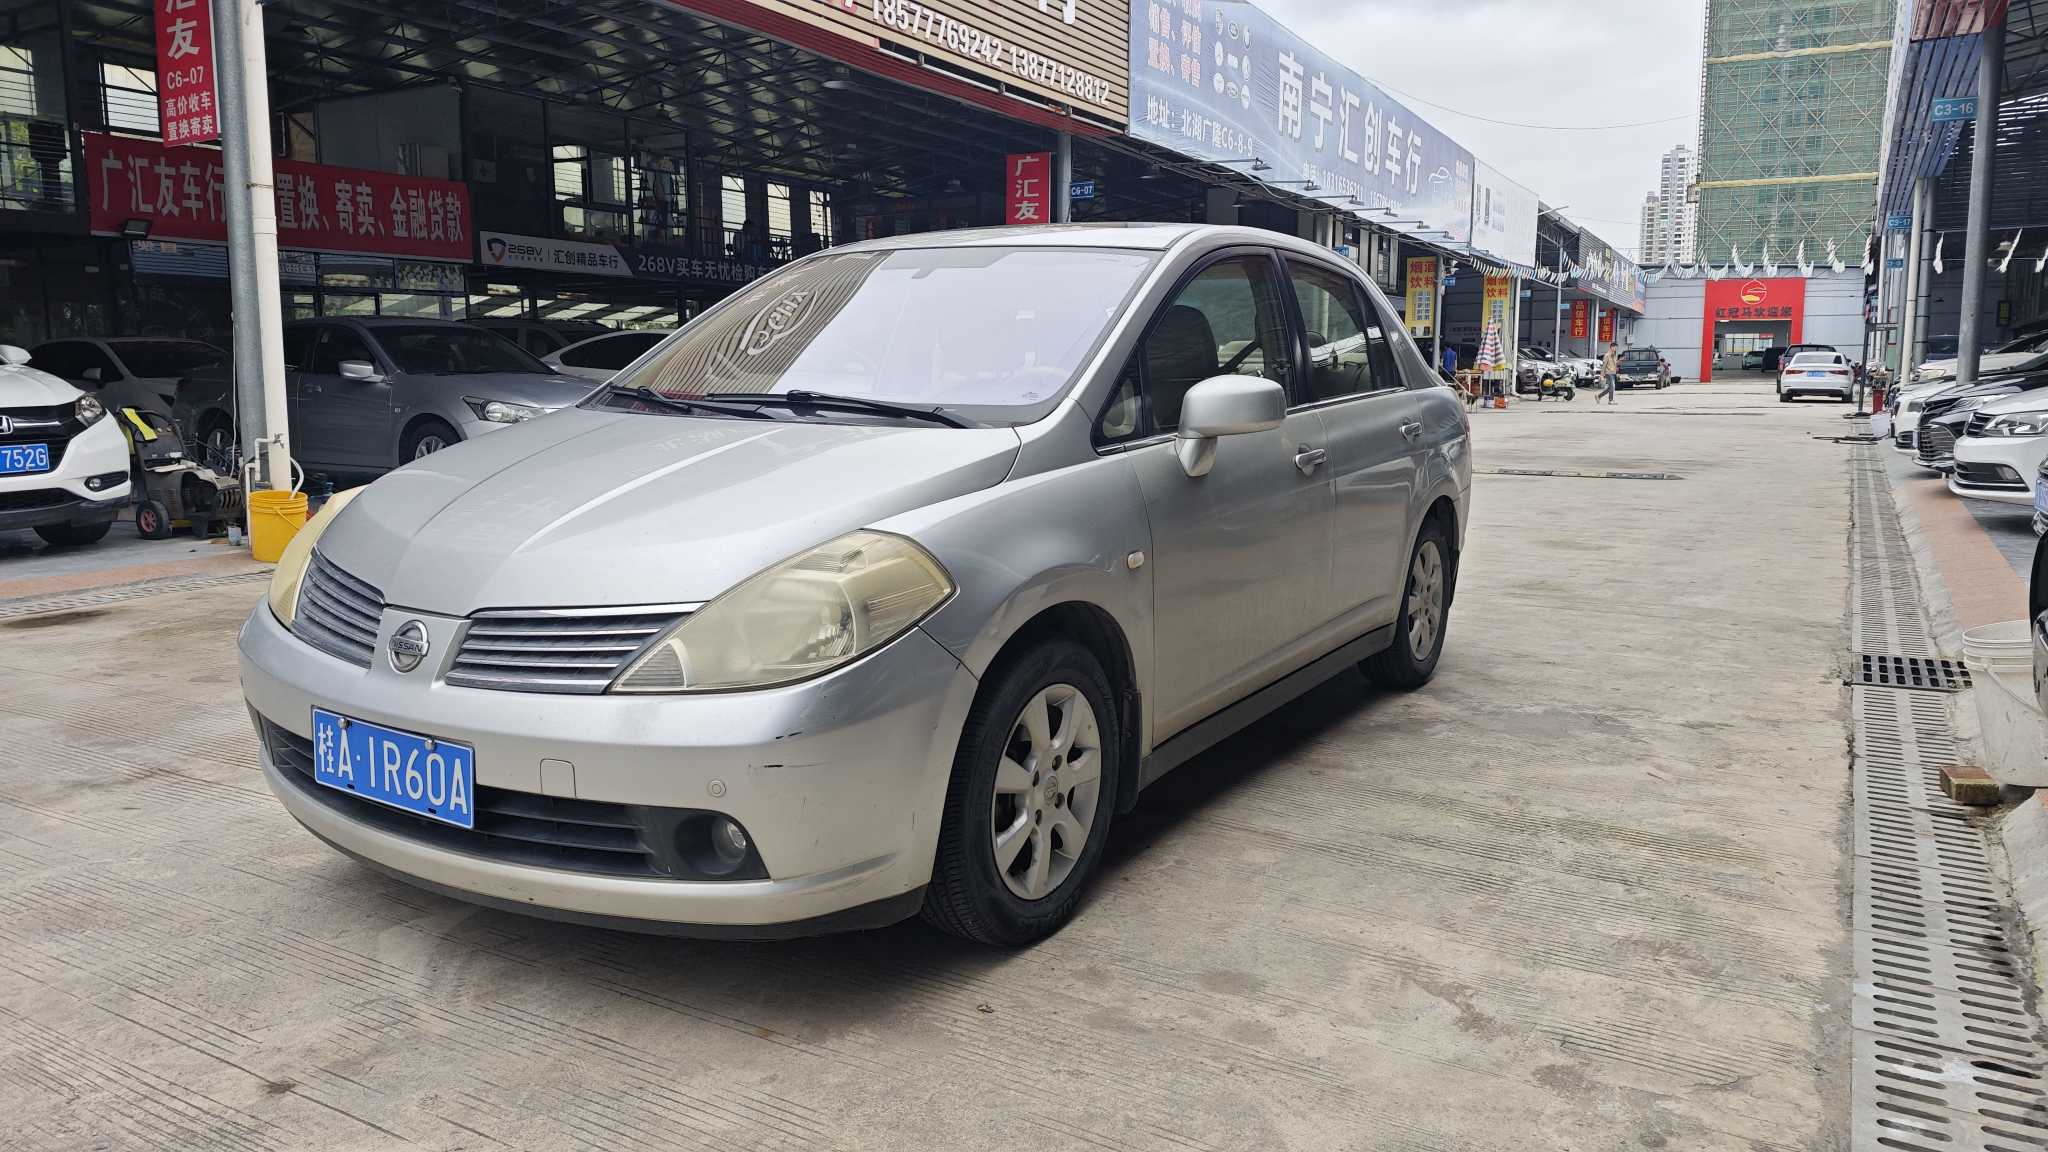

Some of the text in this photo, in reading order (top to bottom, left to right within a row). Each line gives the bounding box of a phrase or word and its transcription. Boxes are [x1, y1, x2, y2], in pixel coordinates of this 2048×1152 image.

[872, 0, 1110, 106] 18577769242 13877128812
[167, 66, 204, 89] C6-07
[166, 90, 212, 118] 高价收车
[1934, 102, 1974, 117] C3-16
[167, 114, 214, 142] 置换寄卖
[1279, 50, 1422, 196] 南宁汇创车行
[102, 150, 463, 242] 广汇友车行 置换、寄卖、金融贷款
[1015, 156, 1040, 220] 广汇友
[554, 248, 618, 269] 汇创精品车行
[1, 448, 47, 469] 752G
